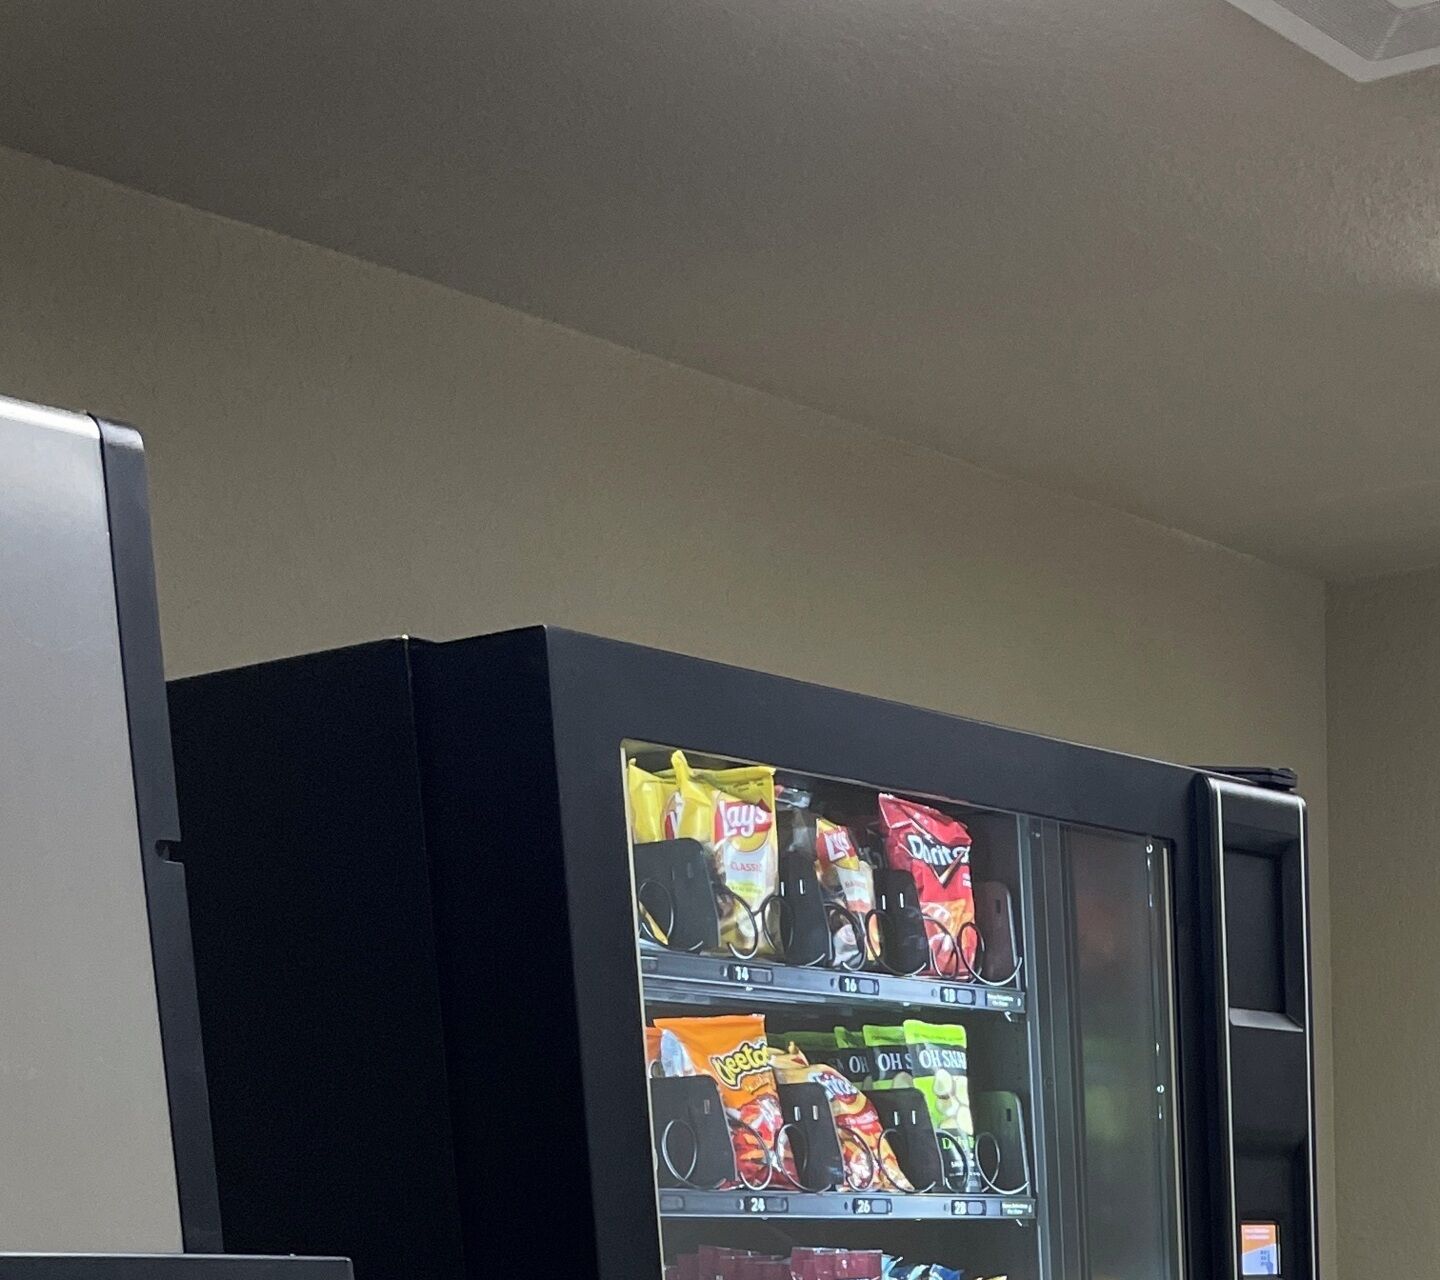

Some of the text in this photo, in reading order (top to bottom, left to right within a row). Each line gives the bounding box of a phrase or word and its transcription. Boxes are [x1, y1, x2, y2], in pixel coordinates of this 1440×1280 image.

[907, 834, 970, 866] Dorito
[734, 967, 750, 981] 14
[844, 978, 857, 993] 16
[878, 1053, 902, 1071] OH
[919, 1050, 940, 1069] OH
[751, 1198, 766, 1212] 24
[857, 1199, 871, 1214] 26
